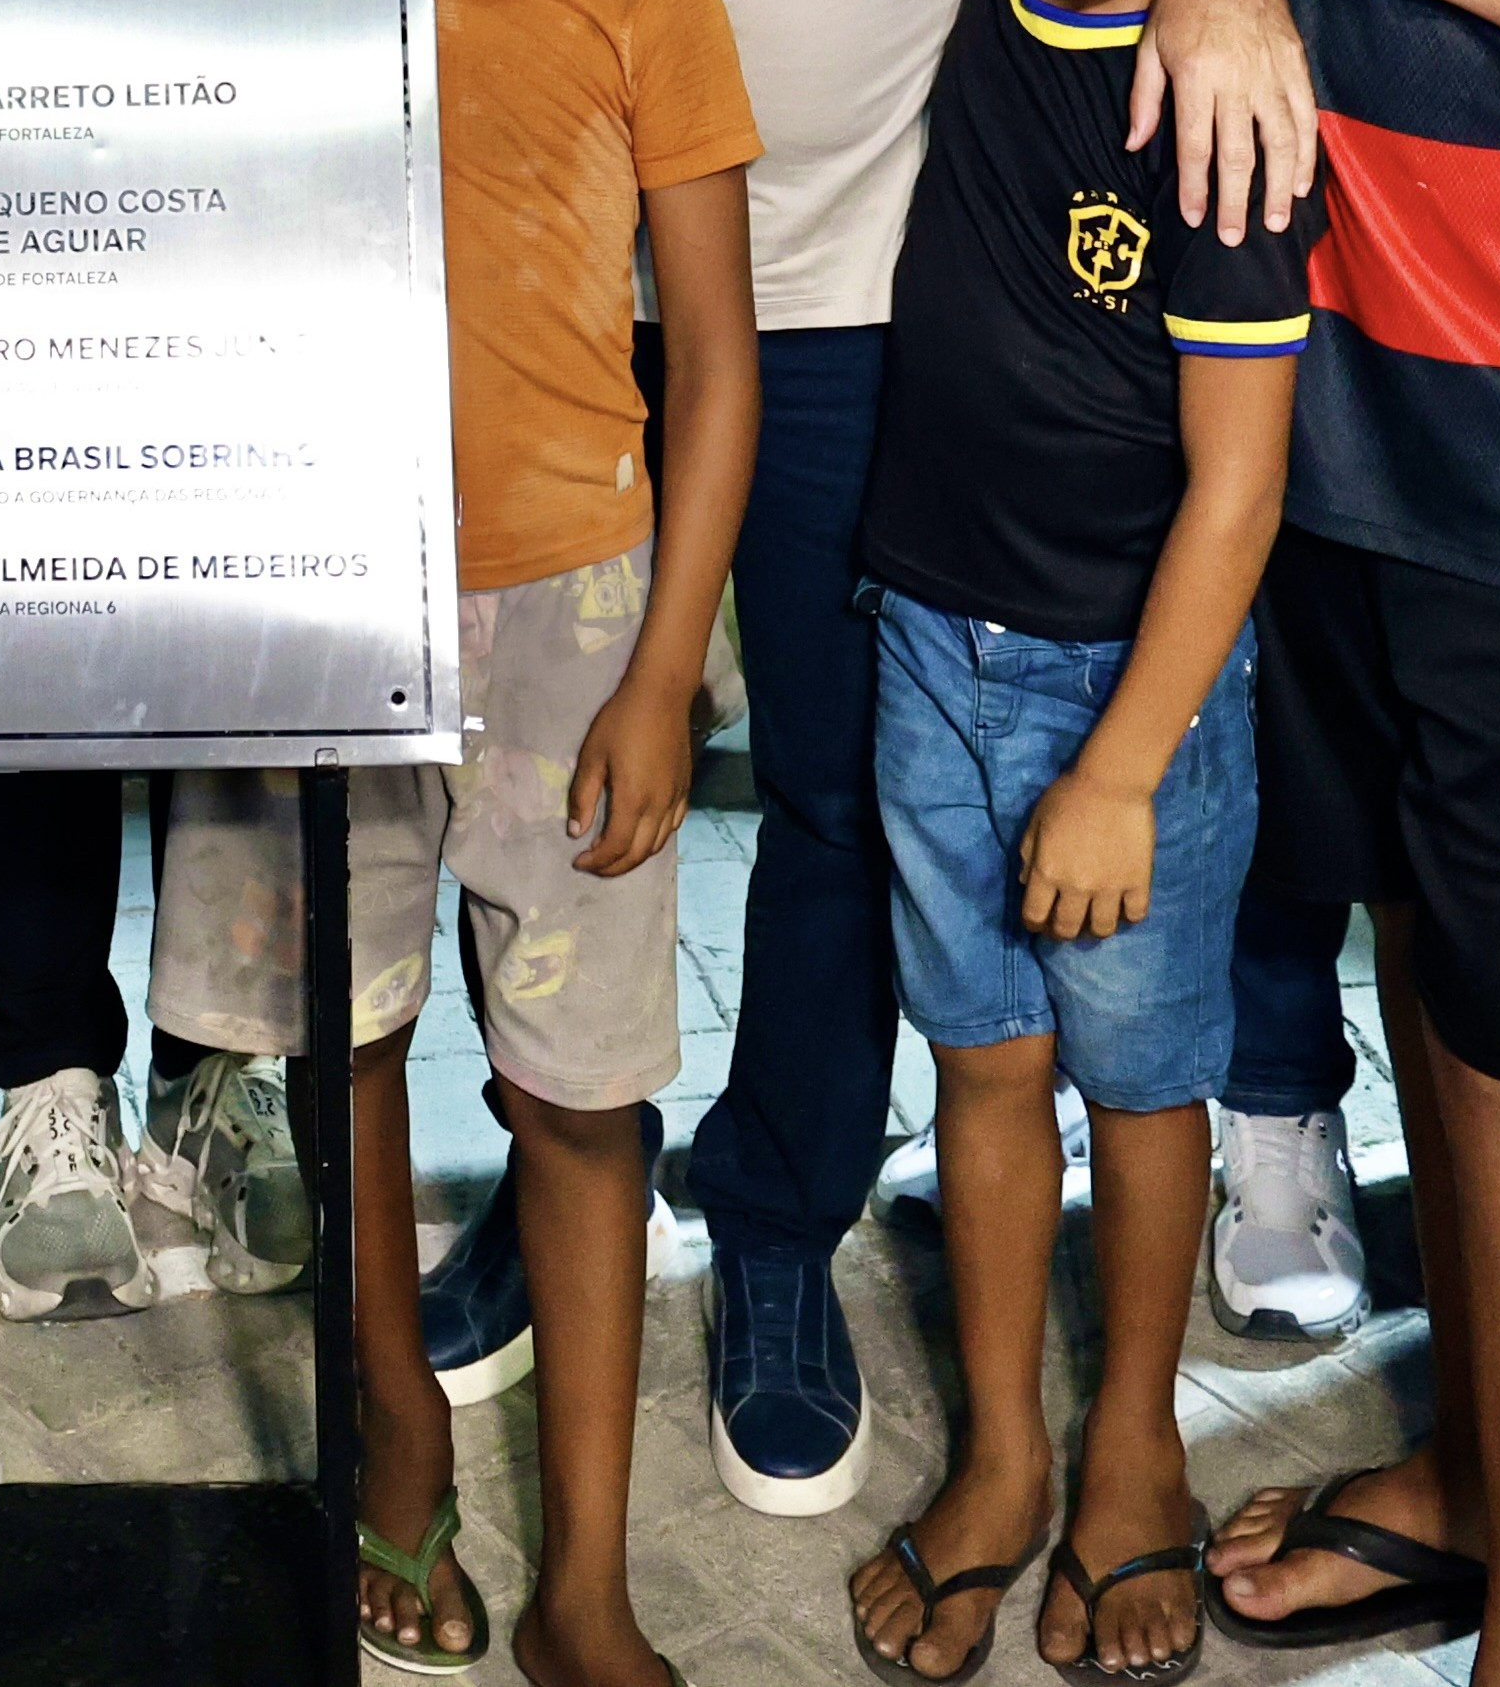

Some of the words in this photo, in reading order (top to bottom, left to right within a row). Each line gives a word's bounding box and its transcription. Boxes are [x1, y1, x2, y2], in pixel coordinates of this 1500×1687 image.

[126, 75, 238, 107] LEITÃO
[0, 126, 95, 142] FORTALEZA
[117, 188, 228, 214] COSTA
[20, 227, 149, 254] AGUIAR
[22, 271, 119, 287] FORTALEZA
[49, 336, 202, 360] MENEZES
[15, 445, 131, 472] BRASIL
[30, 489, 150, 505] GOVERNANÇA
[138, 555, 180, 580] DE
[193, 552, 370, 579] MEDEIROS
[15, 600, 102, 617] REGIONAL
[107, 600, 117, 615] 6
